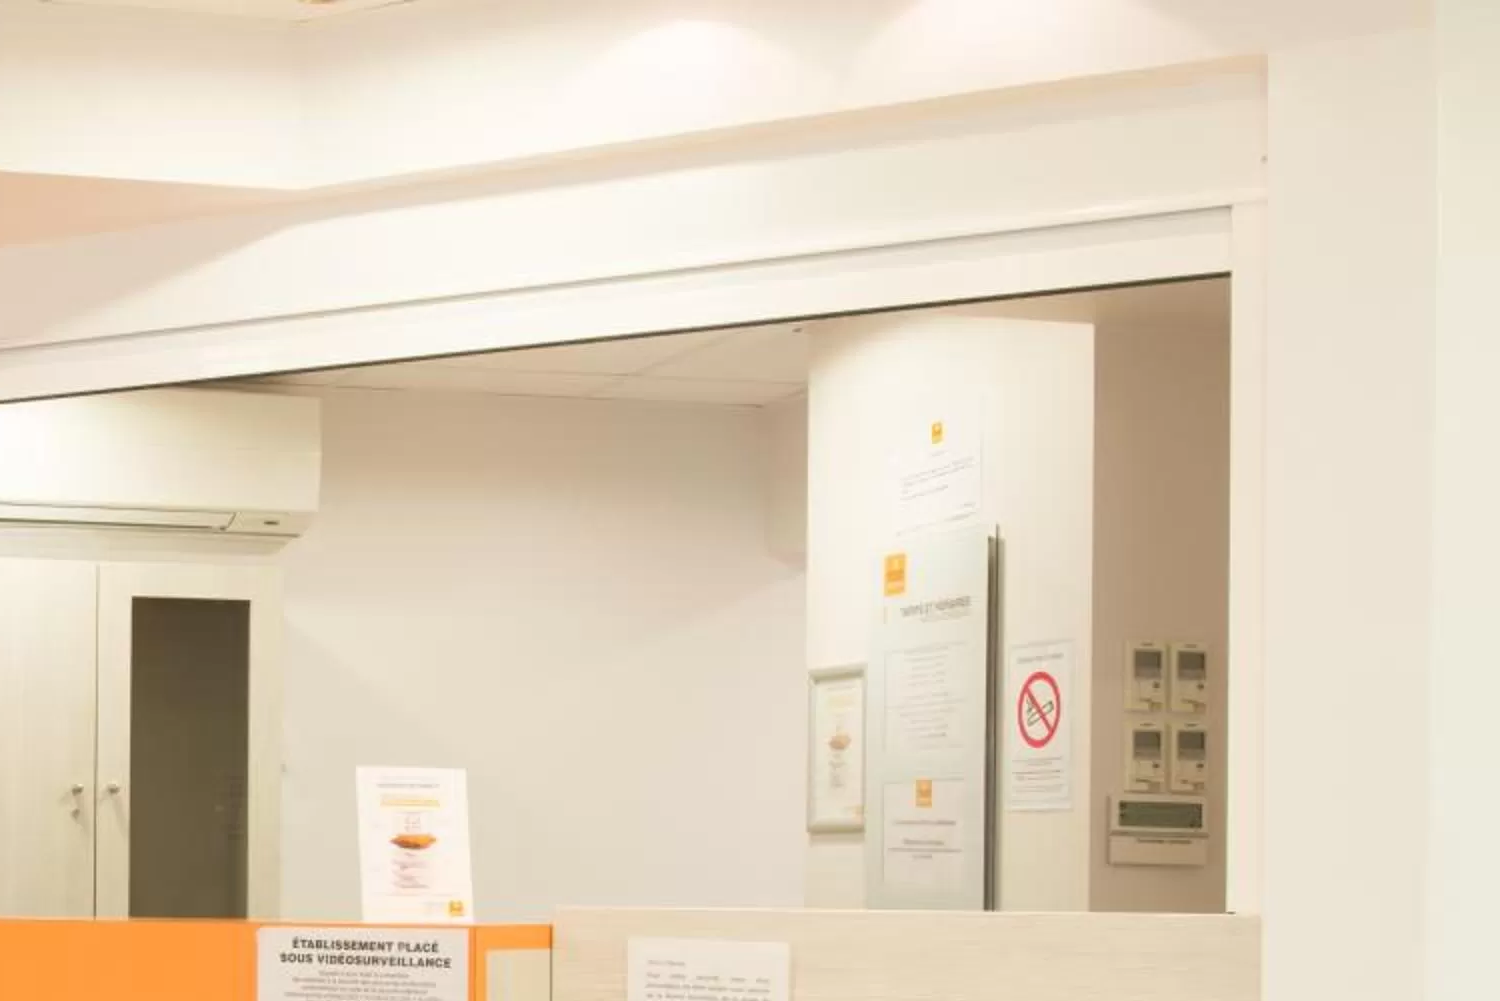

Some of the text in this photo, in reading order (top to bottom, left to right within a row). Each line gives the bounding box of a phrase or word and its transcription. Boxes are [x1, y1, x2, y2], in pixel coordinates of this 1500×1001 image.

[292, 936, 439, 953] ÉTABLISSEMENT PLACÉ
[280, 953, 452, 969] SOUS VIDÉOSURVEILLANCE
